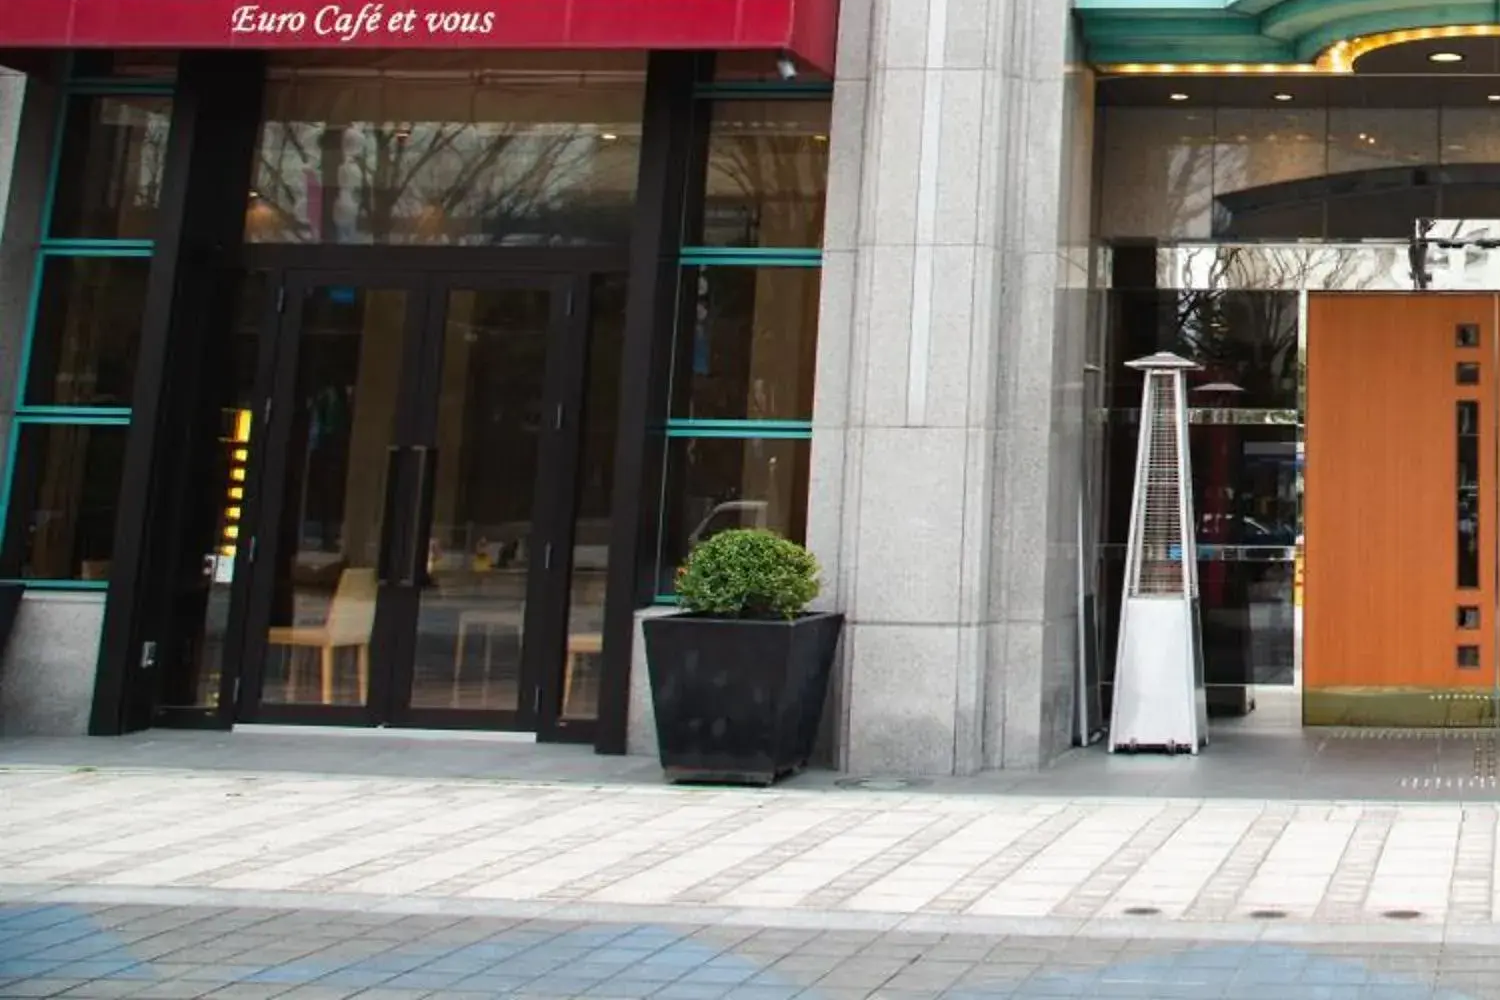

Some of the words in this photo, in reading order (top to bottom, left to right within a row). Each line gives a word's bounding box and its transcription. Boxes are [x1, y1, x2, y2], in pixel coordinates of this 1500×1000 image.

[231, 5, 306, 33] Euro
[314, 3, 384, 41] Café
[387, 10, 416, 33] et
[424, 10, 495, 33] vous
